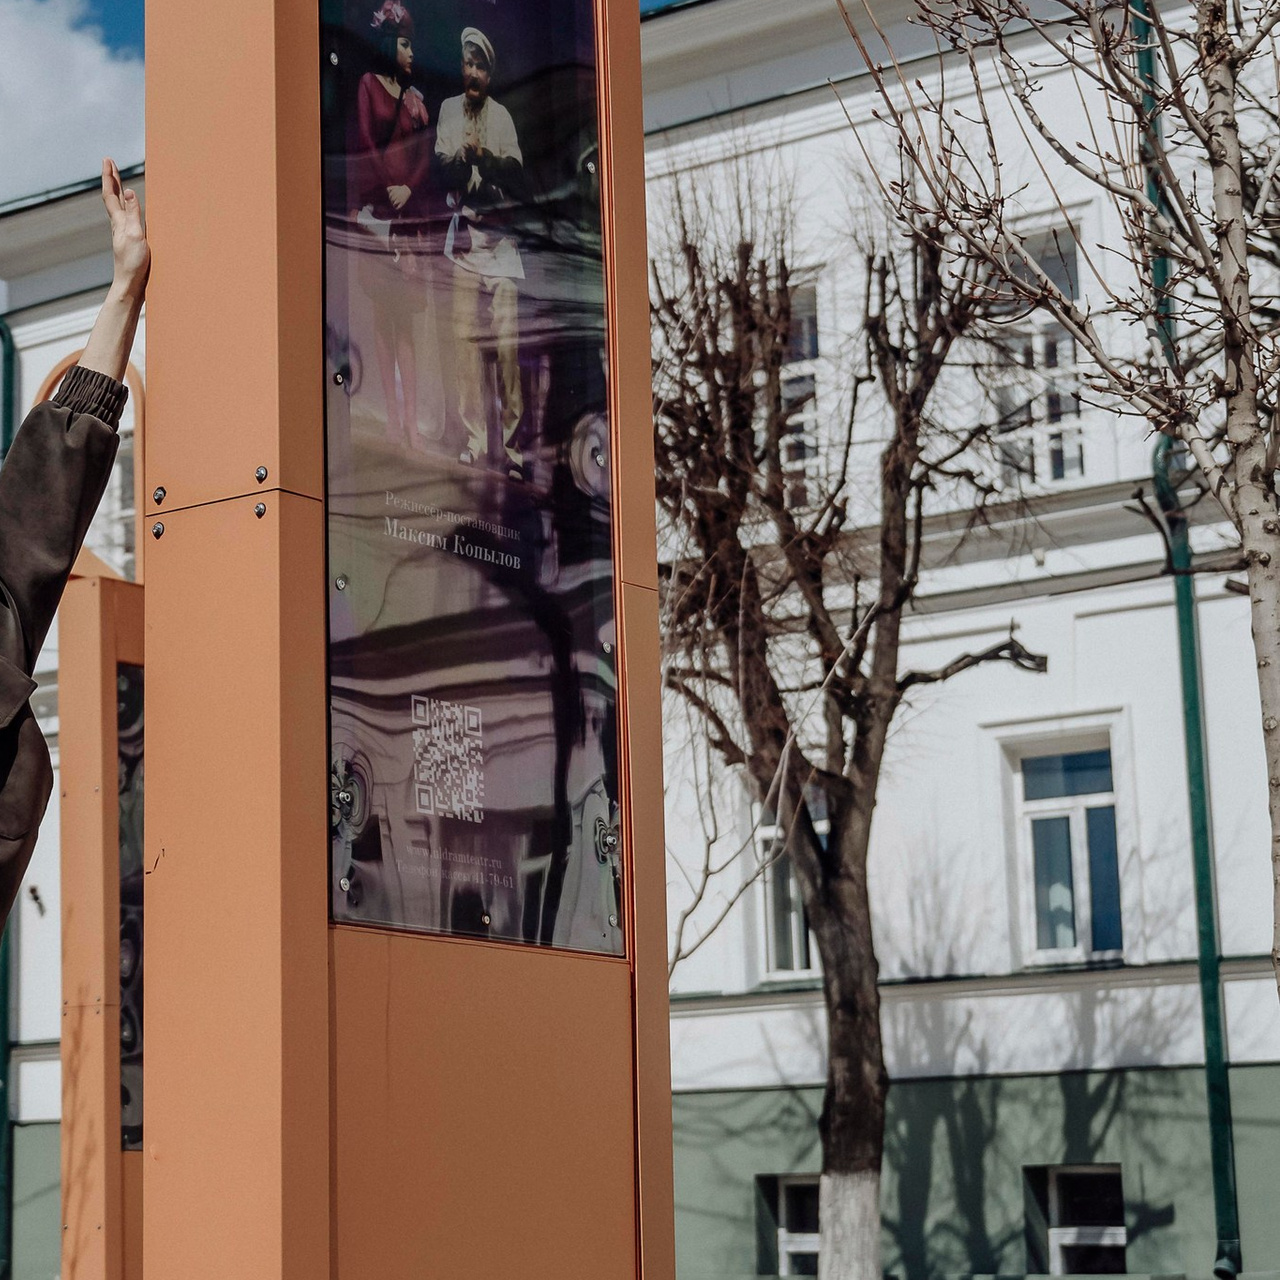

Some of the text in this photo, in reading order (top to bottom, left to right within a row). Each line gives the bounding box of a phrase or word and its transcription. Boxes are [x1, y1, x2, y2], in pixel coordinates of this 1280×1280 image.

[385, 490, 521, 541] Режиссёр-постановщик
[383, 516, 521, 570] Максим Копылов
[406, 846, 502, 869] www.uldramteatr.ru
